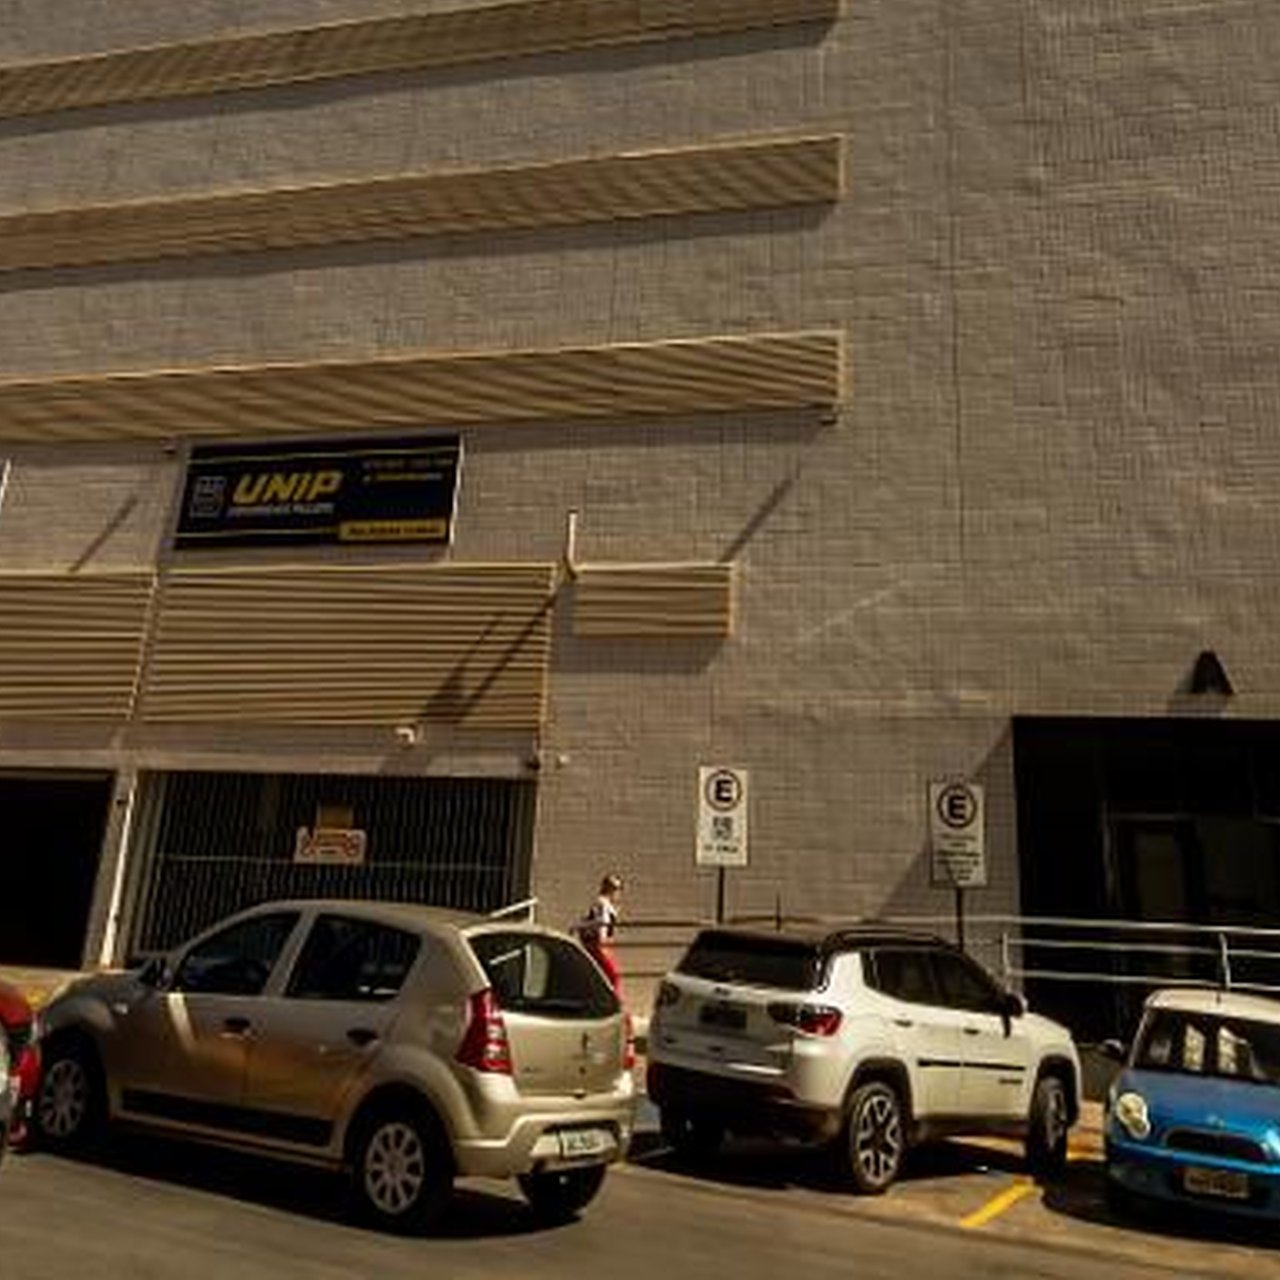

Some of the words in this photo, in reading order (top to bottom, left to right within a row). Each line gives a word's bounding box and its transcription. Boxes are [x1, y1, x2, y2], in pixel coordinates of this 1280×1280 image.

[232, 470, 343, 504] UNIP
[714, 779, 733, 802] E
[947, 794, 967, 820] E
